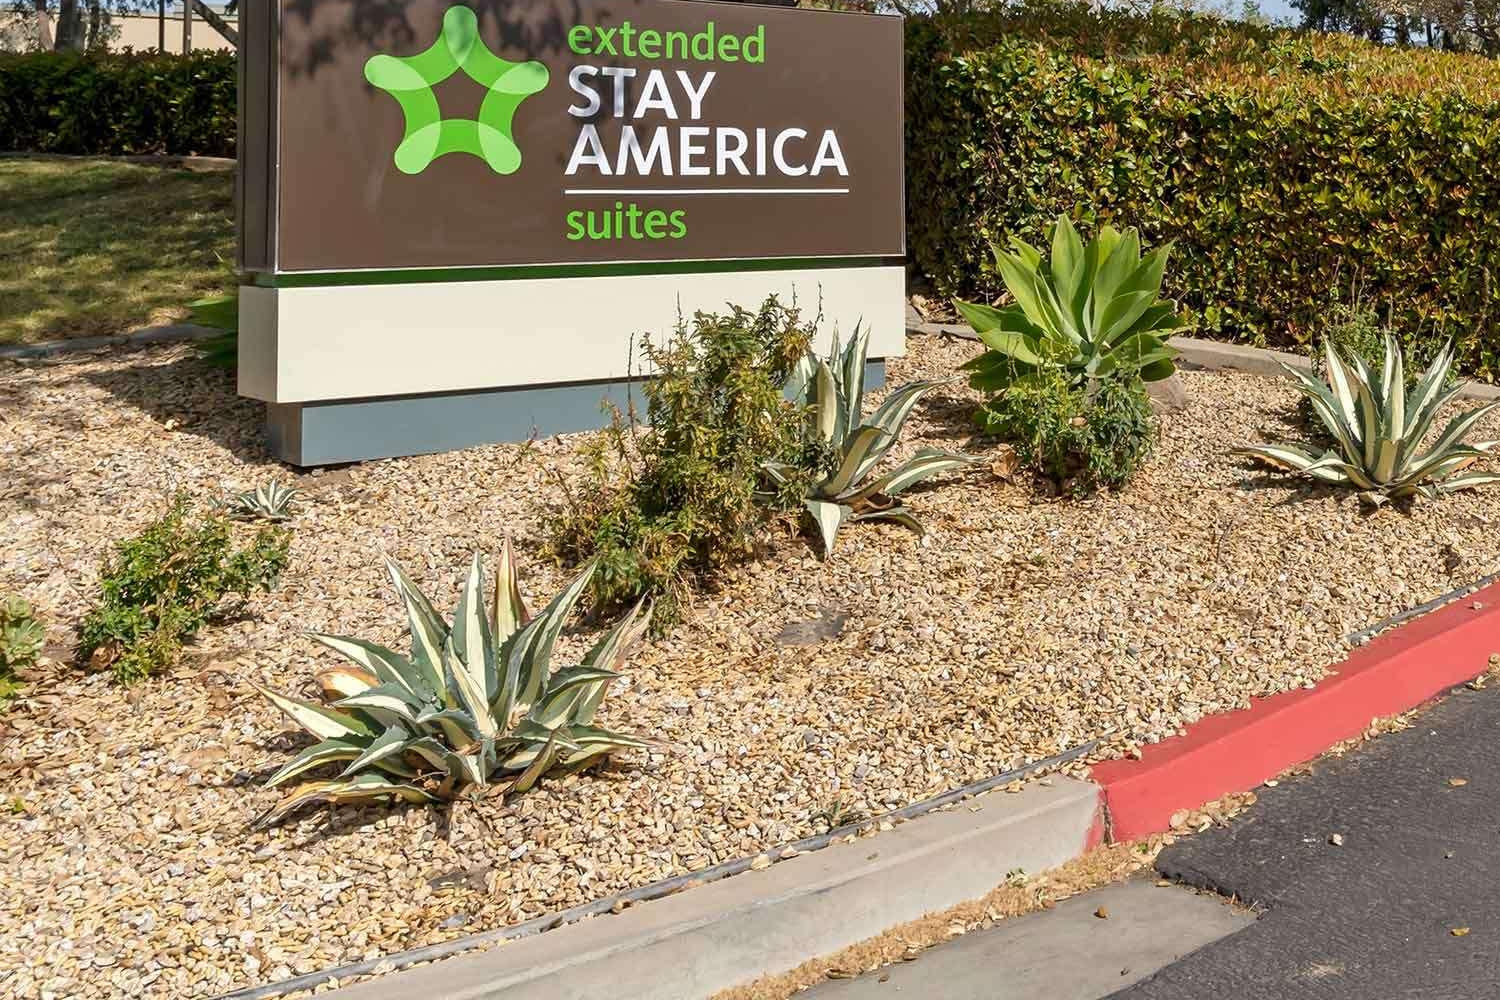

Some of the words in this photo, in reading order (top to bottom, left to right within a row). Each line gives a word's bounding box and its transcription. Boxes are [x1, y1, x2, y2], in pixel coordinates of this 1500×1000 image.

[566, 21, 766, 63] extended
[567, 64, 717, 120] STAY
[564, 124, 850, 177] AMERICA
[565, 202, 687, 241] suites
